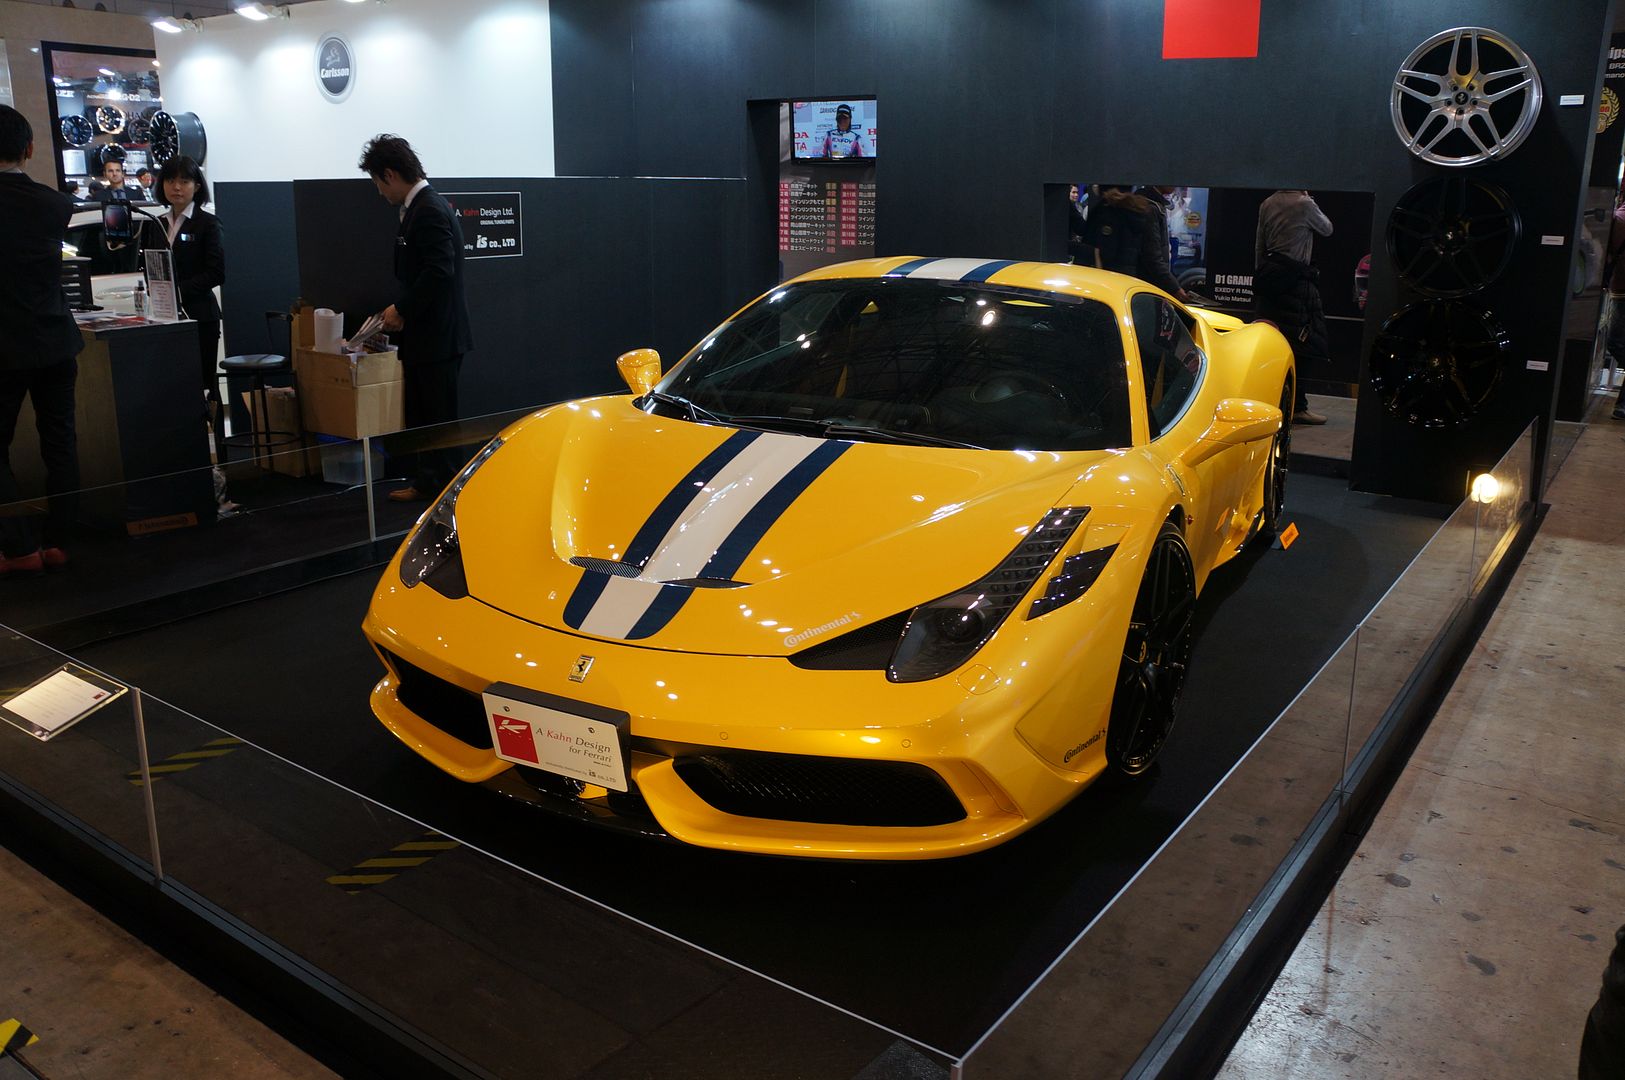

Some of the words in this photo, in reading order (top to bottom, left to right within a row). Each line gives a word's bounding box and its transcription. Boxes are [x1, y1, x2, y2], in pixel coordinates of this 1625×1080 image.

[321, 67, 349, 78] Carlsson
[464, 208, 479, 216] Kahn
[480, 208, 501, 218] Design
[502, 208, 514, 216] Ltd.
[1215, 274, 1225, 284] D1
[783, 614, 852, 648] Continental
[535, 727, 544, 737] A
[546, 729, 572, 744] Kahn
[575, 736, 611, 753] Design
[1063, 730, 1101, 764] Continental
[568, 745, 581, 755] for
[583, 749, 612, 763] Ferrari
